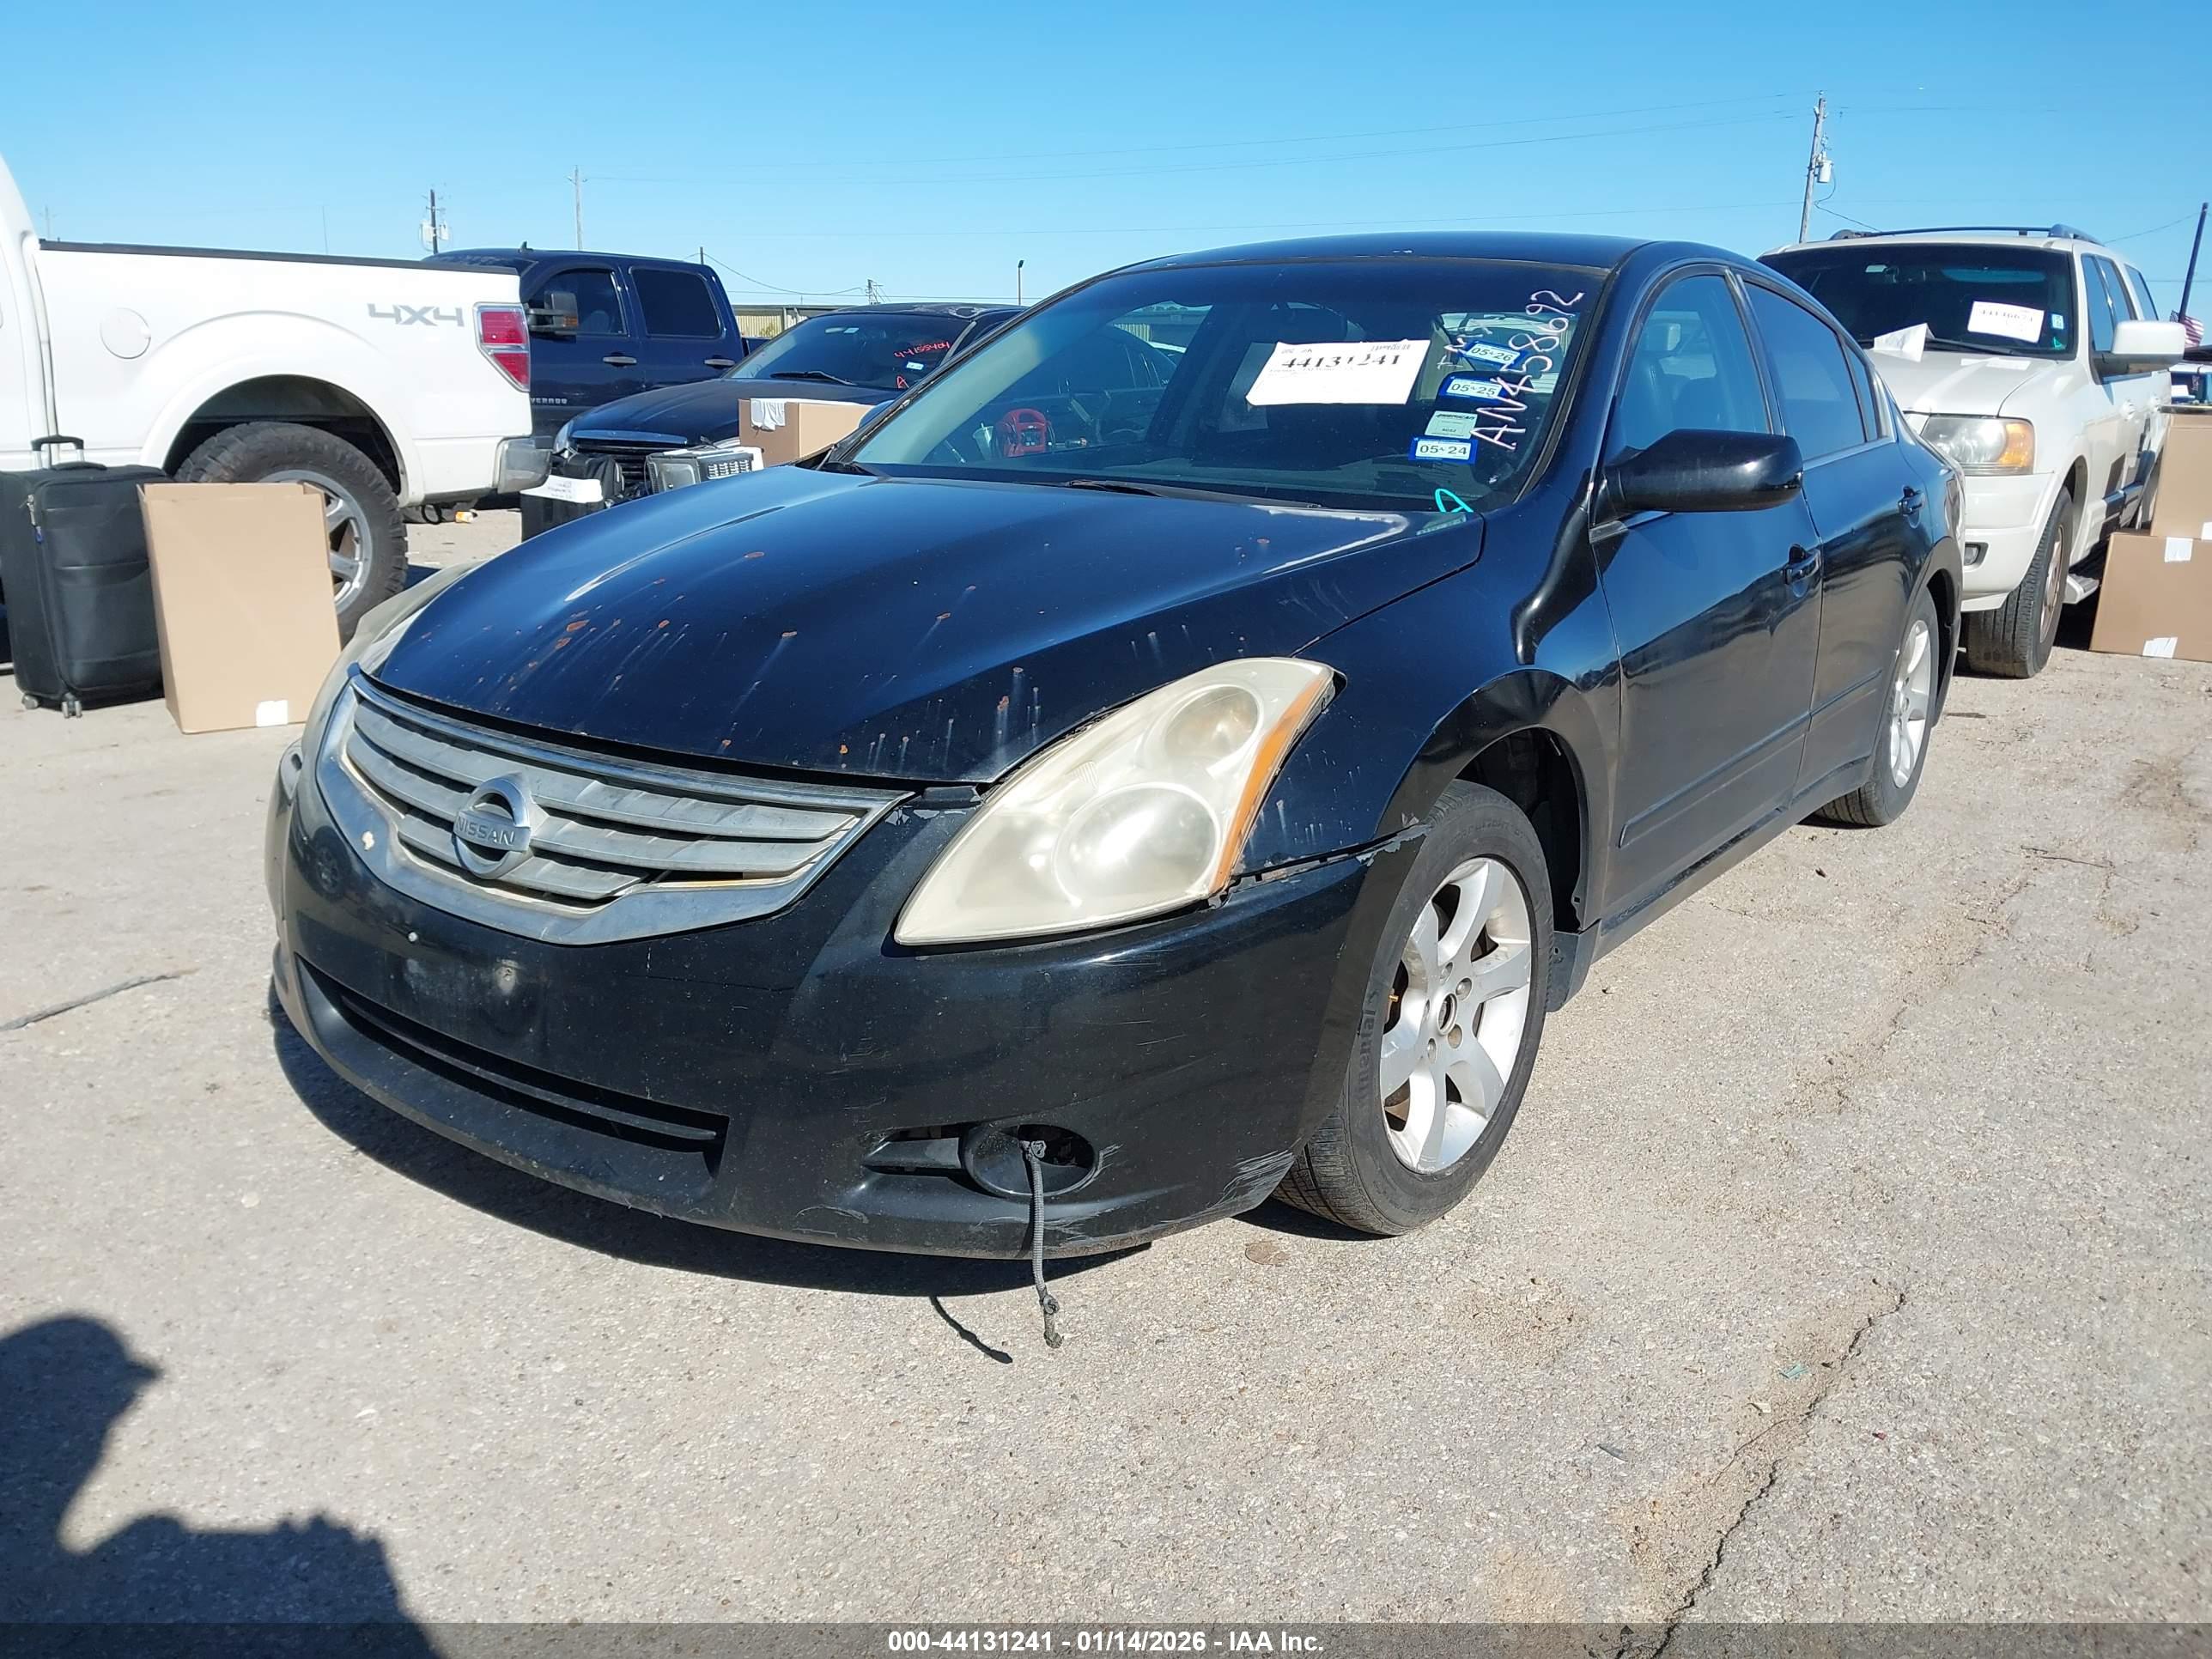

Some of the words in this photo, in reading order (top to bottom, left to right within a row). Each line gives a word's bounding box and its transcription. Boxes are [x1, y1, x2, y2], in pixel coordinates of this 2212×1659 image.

[367, 303, 465, 327] 4X4
[1281, 354, 1401, 368] 44131241
[456, 817, 515, 846] NISSAN
